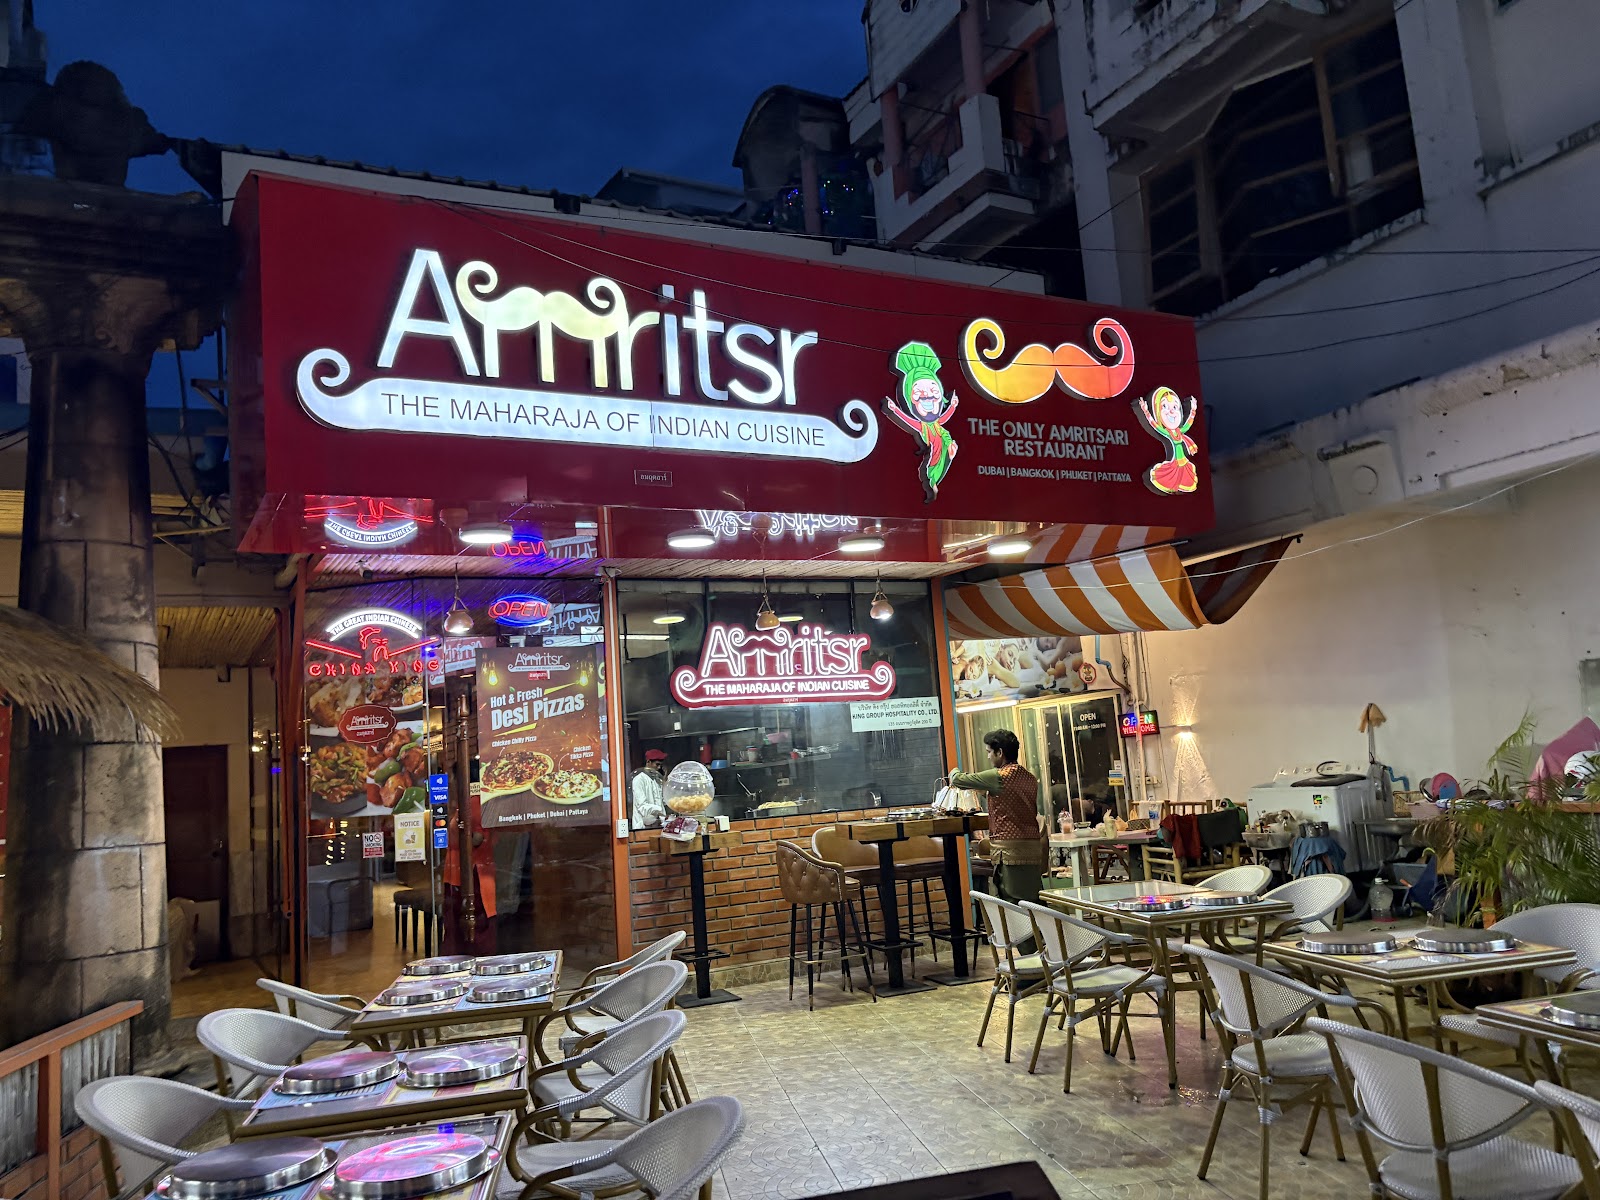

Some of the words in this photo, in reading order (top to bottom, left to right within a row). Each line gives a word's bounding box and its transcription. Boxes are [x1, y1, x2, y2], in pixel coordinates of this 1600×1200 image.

[376, 248, 818, 405] Amritsr
[381, 392, 440, 418] THE
[450, 398, 600, 430] MAHARAJA
[607, 411, 640, 433] OF
[649, 414, 730, 440] INDIAN
[737, 422, 826, 447] CUISINE
[967, 417, 1000, 436] THE
[1002, 420, 1045, 439] ONLY
[1049, 424, 1129, 446] AMRITSARI
[1003, 439, 1106, 461] RESTAURANT
[977, 465, 1005, 476] DUBAI
[1010, 467, 1055, 479] BANGKOK
[1061, 470, 1092, 480] PHUKET
[1098, 472, 1132, 482] PATTAYA
[489, 600, 550, 618] OPEN
[332, 625, 345, 636] THE
[344, 615, 365, 628] GREAT
[365, 613, 389, 622] INDIAN
[390, 616, 418, 633] CHINESE
[700, 624, 868, 677] Amritsr
[308, 661, 376, 677] CHINA
[388, 659, 440, 674] KING
[514, 653, 564, 666] Amritsr
[703, 684, 726, 696] THE
[727, 682, 781, 695] MAHARAJA
[783, 681, 796, 693] OF
[798, 680, 831, 692] INDIAN
[832, 679, 870, 691] CUISINE
[490, 695, 507, 708] Hot
[508, 693, 515, 704] &
[517, 687, 543, 702] Fresh
[350, 714, 385, 726] Amritsr
[491, 702, 529, 731] Desi
[533, 693, 585, 721] Pizzas
[866, 711, 885, 719] GROUP
[885, 710, 917, 718] HOSPITALITY
[1079, 712, 1097, 722] OPEN
[1122, 724, 1156, 734] WELOME
[491, 739, 511, 747] Chicken
[573, 745, 592, 753] Chicken
[498, 815, 522, 823] Bangkok
[550, 810, 565, 818] Dubai
